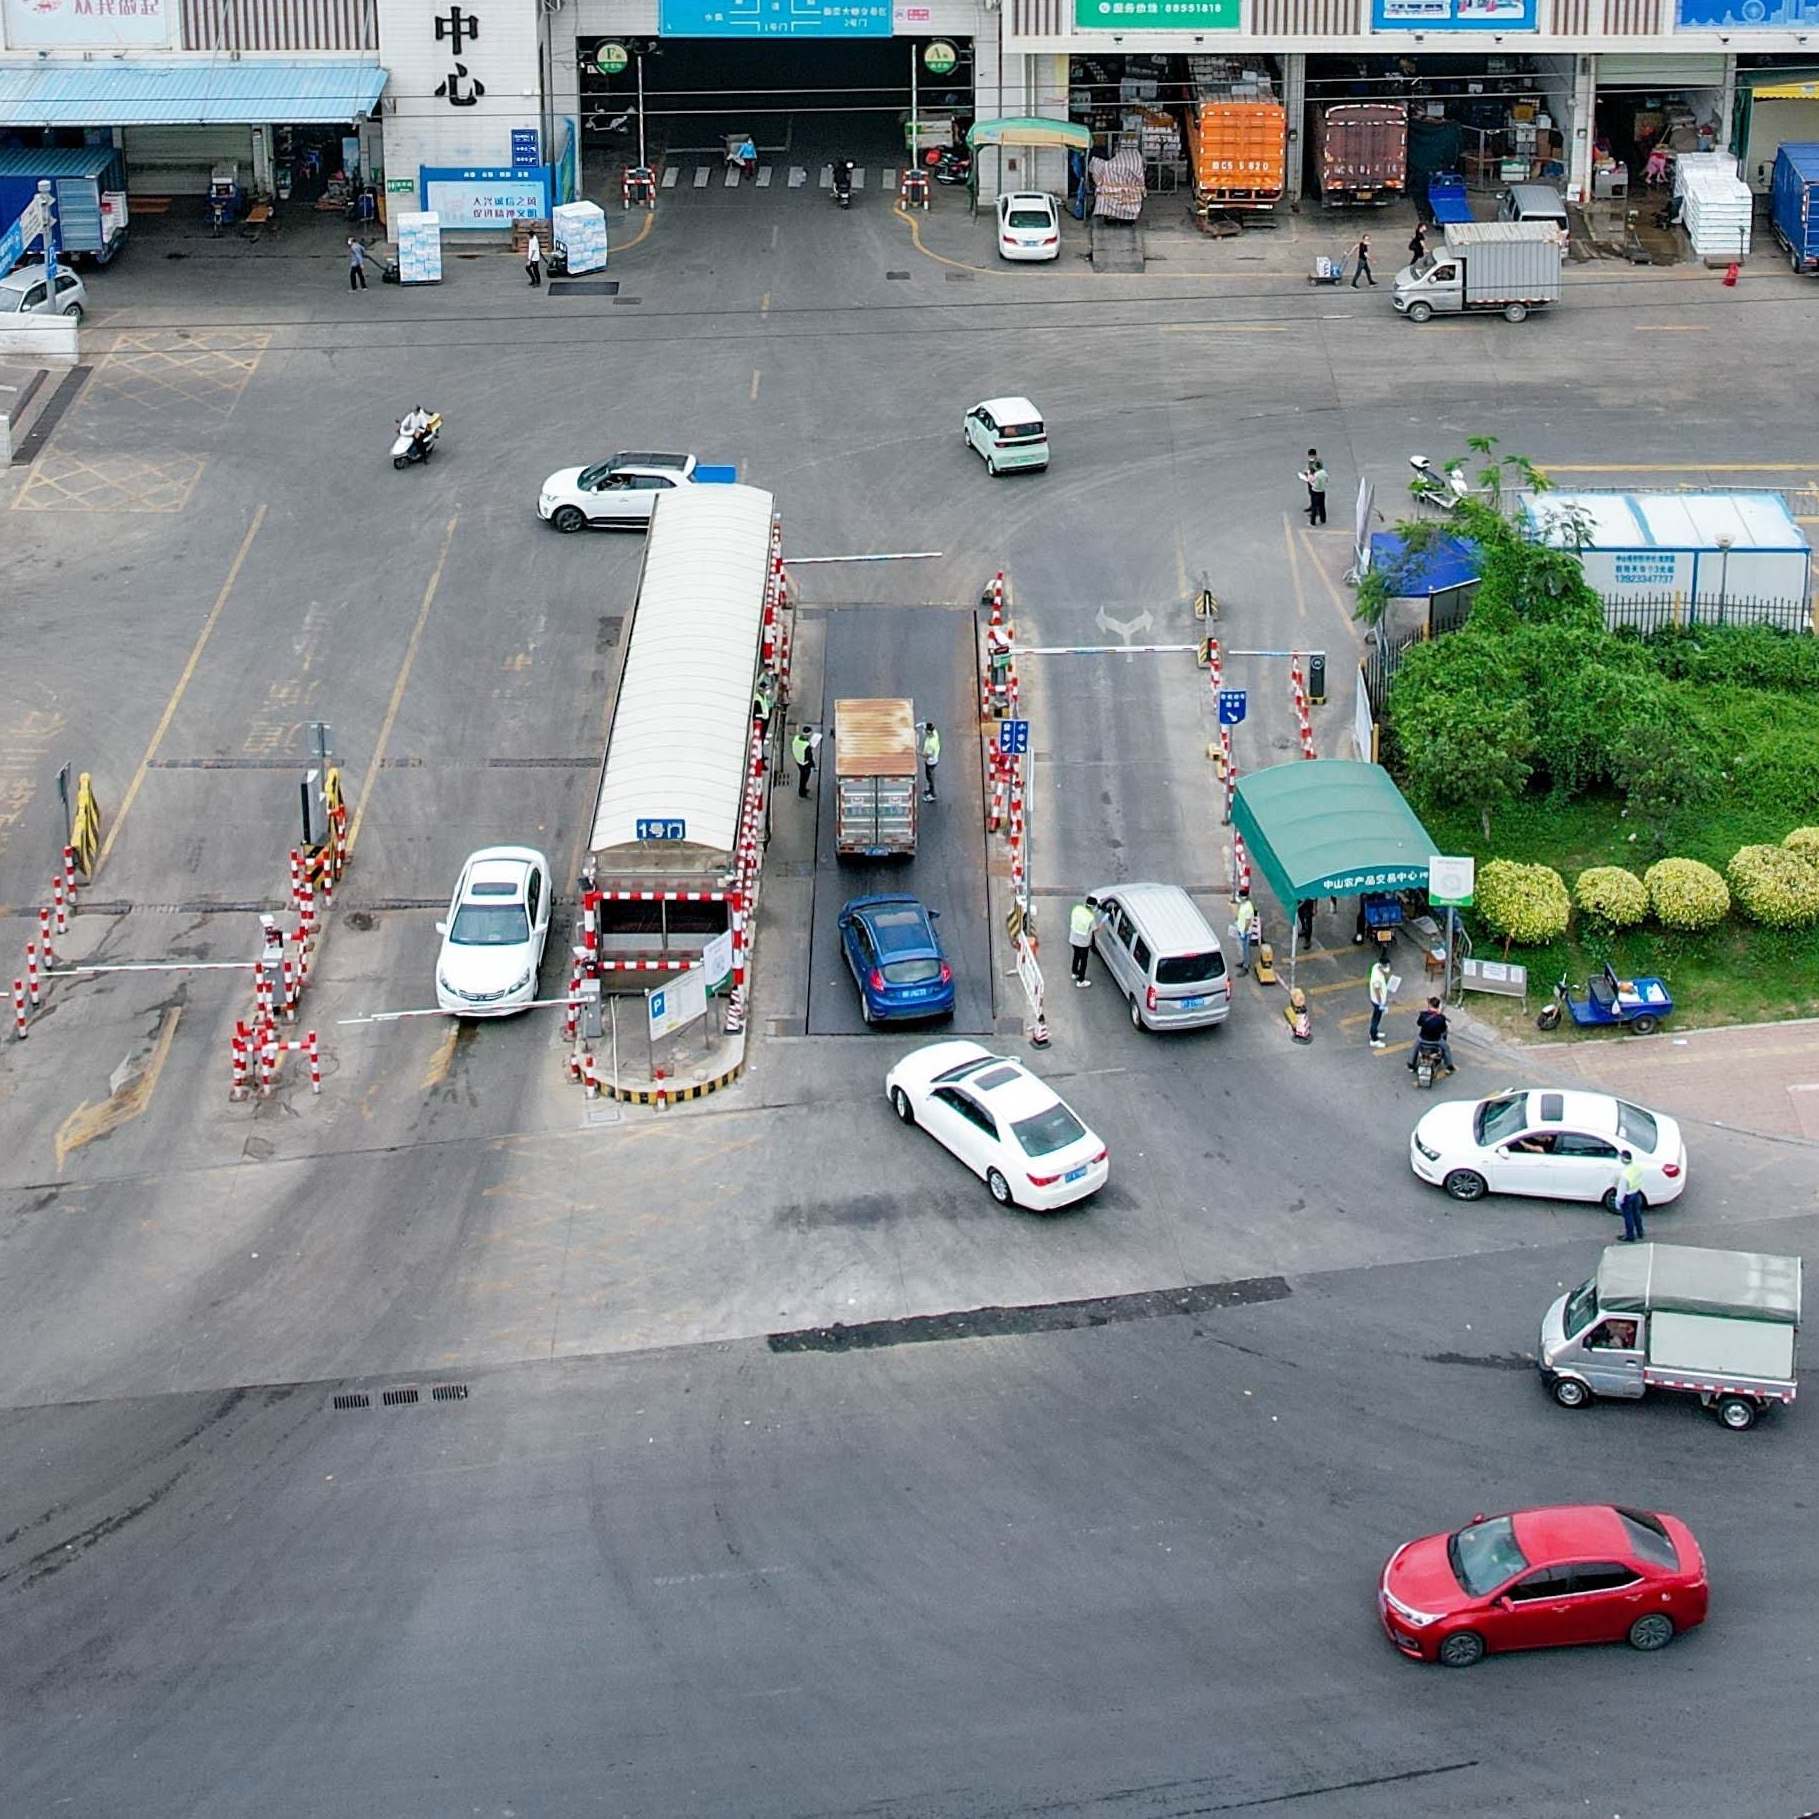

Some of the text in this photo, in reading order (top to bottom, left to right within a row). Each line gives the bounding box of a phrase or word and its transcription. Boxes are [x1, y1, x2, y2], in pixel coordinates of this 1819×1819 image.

[638, 822, 683, 839] 1号门
[1323, 870, 1418, 891] 中山农产品交易中心
